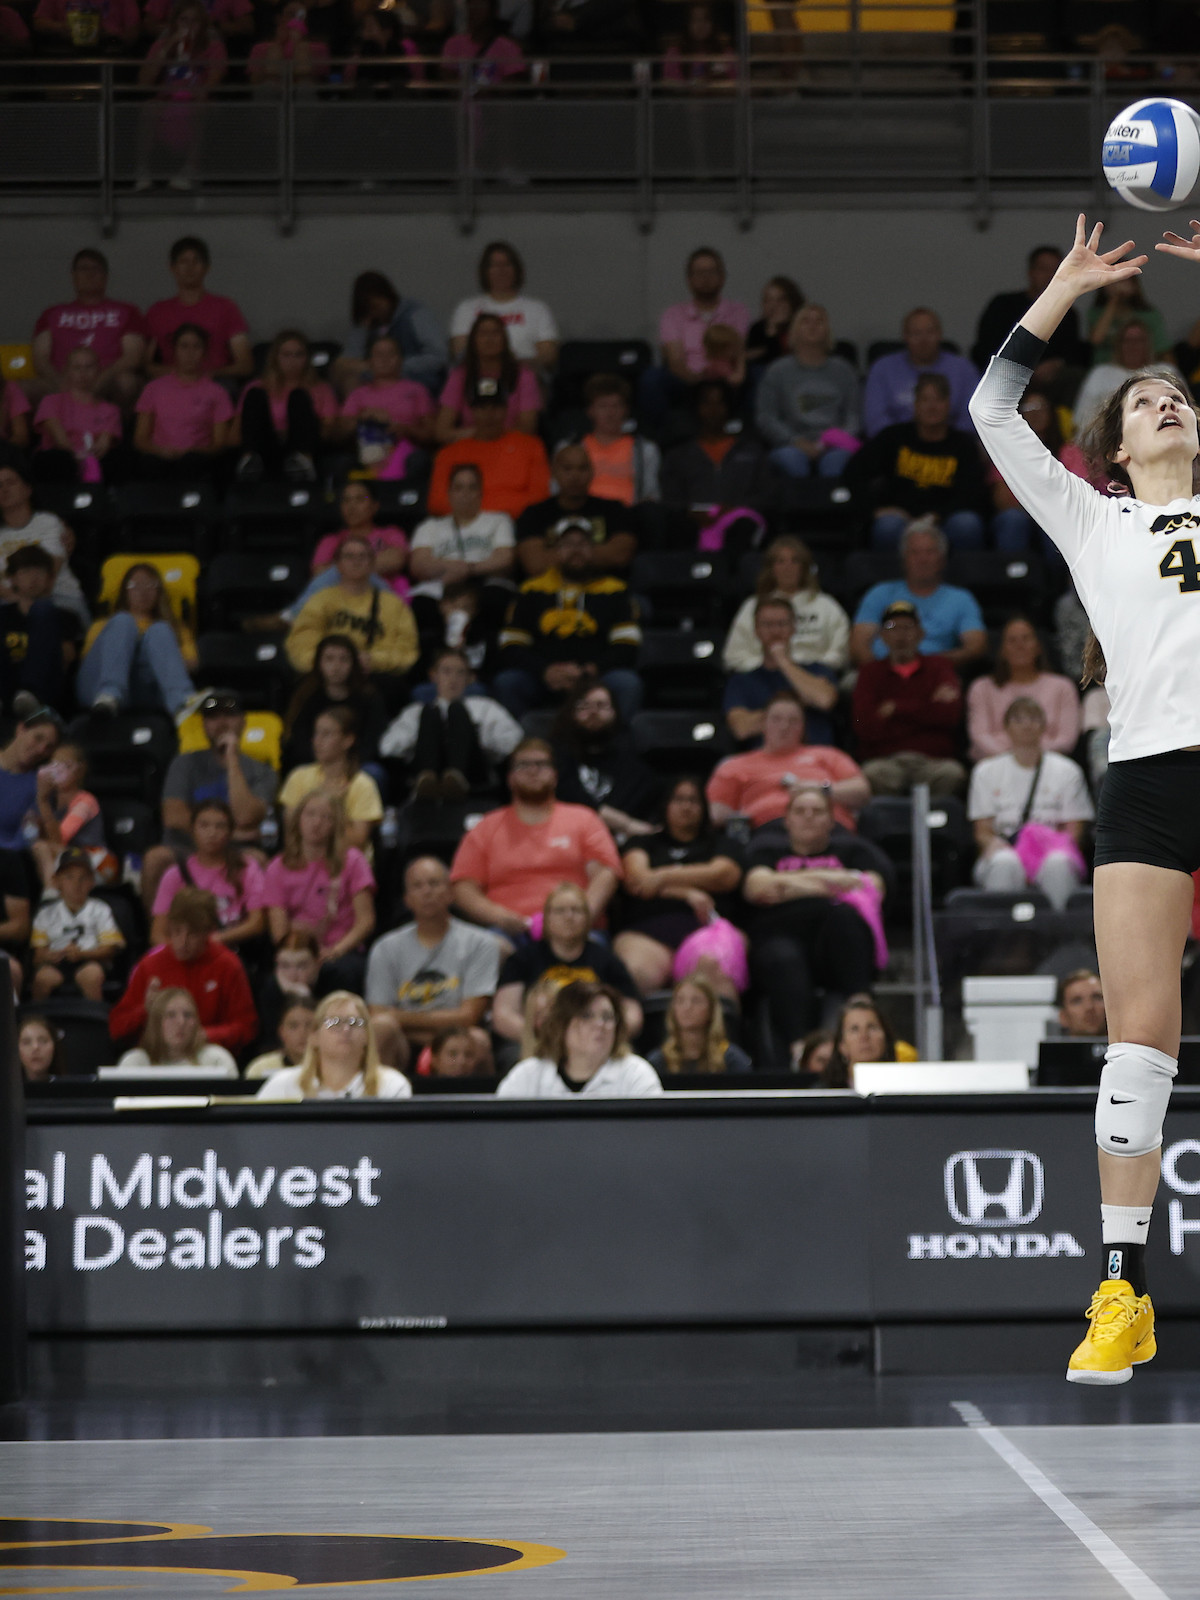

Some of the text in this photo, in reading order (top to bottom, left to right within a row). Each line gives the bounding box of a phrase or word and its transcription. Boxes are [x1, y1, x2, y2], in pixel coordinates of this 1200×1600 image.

[58, 310, 120, 329] HOPE
[90, 1148, 382, 1209] Midwest
[72, 1209, 326, 1271] Dealers
[907, 1232, 1086, 1259] HONDA
